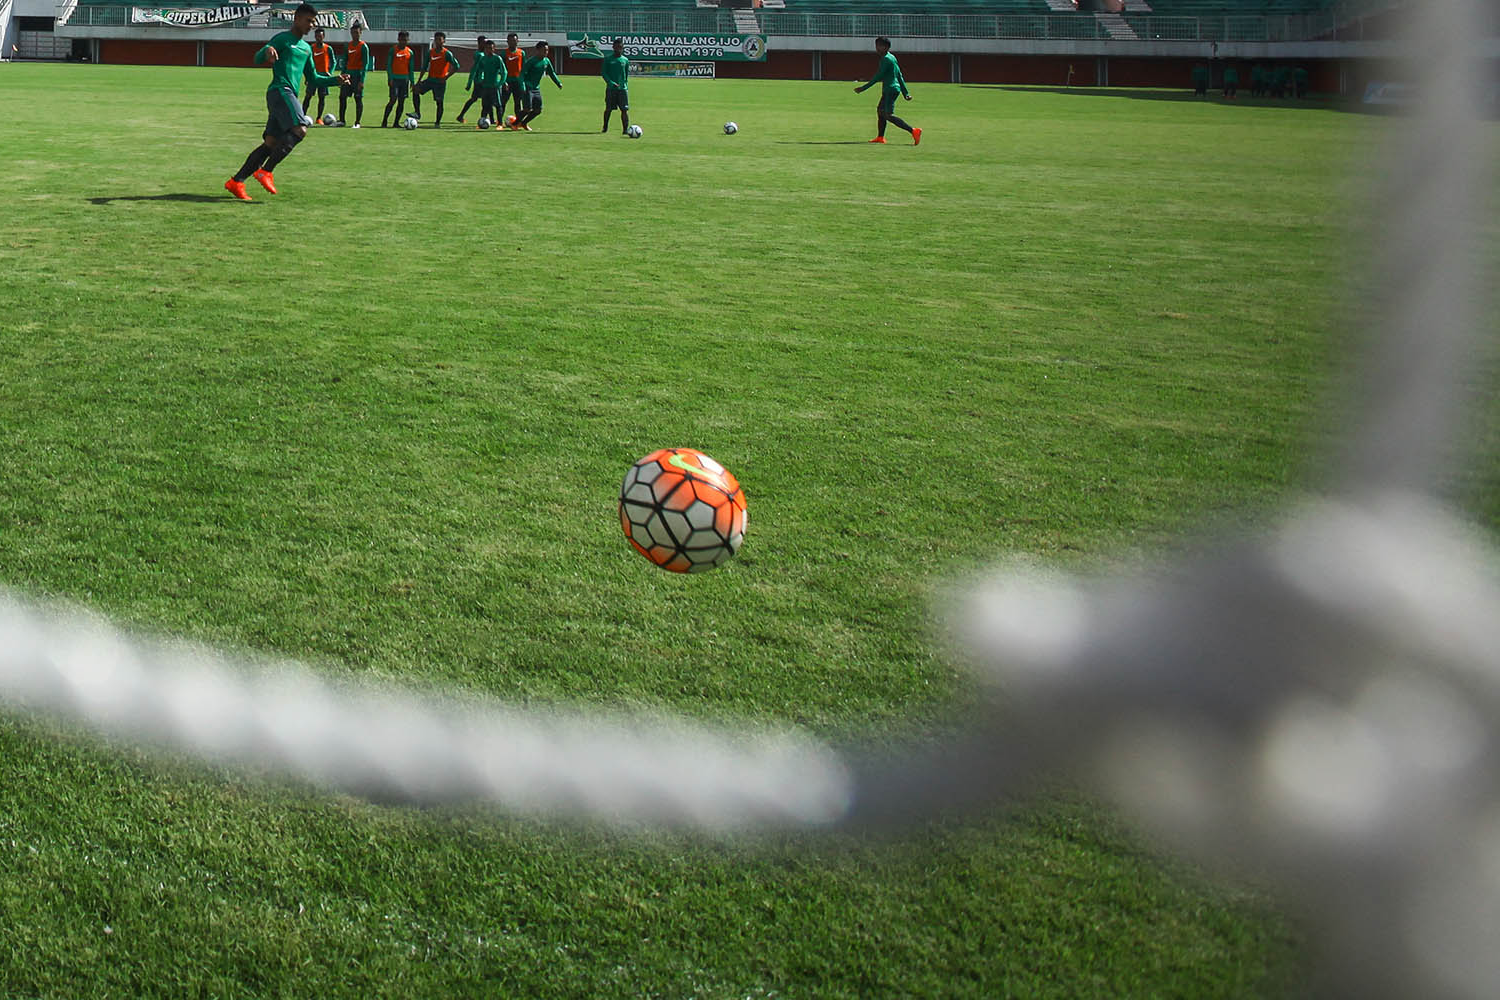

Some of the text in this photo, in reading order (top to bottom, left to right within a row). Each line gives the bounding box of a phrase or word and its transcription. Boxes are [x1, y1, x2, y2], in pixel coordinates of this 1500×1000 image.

[664, 36, 717, 46] WALANG
[720, 37, 741, 46] IJO
[623, 47, 724, 57] SS SLEMAN 1976
